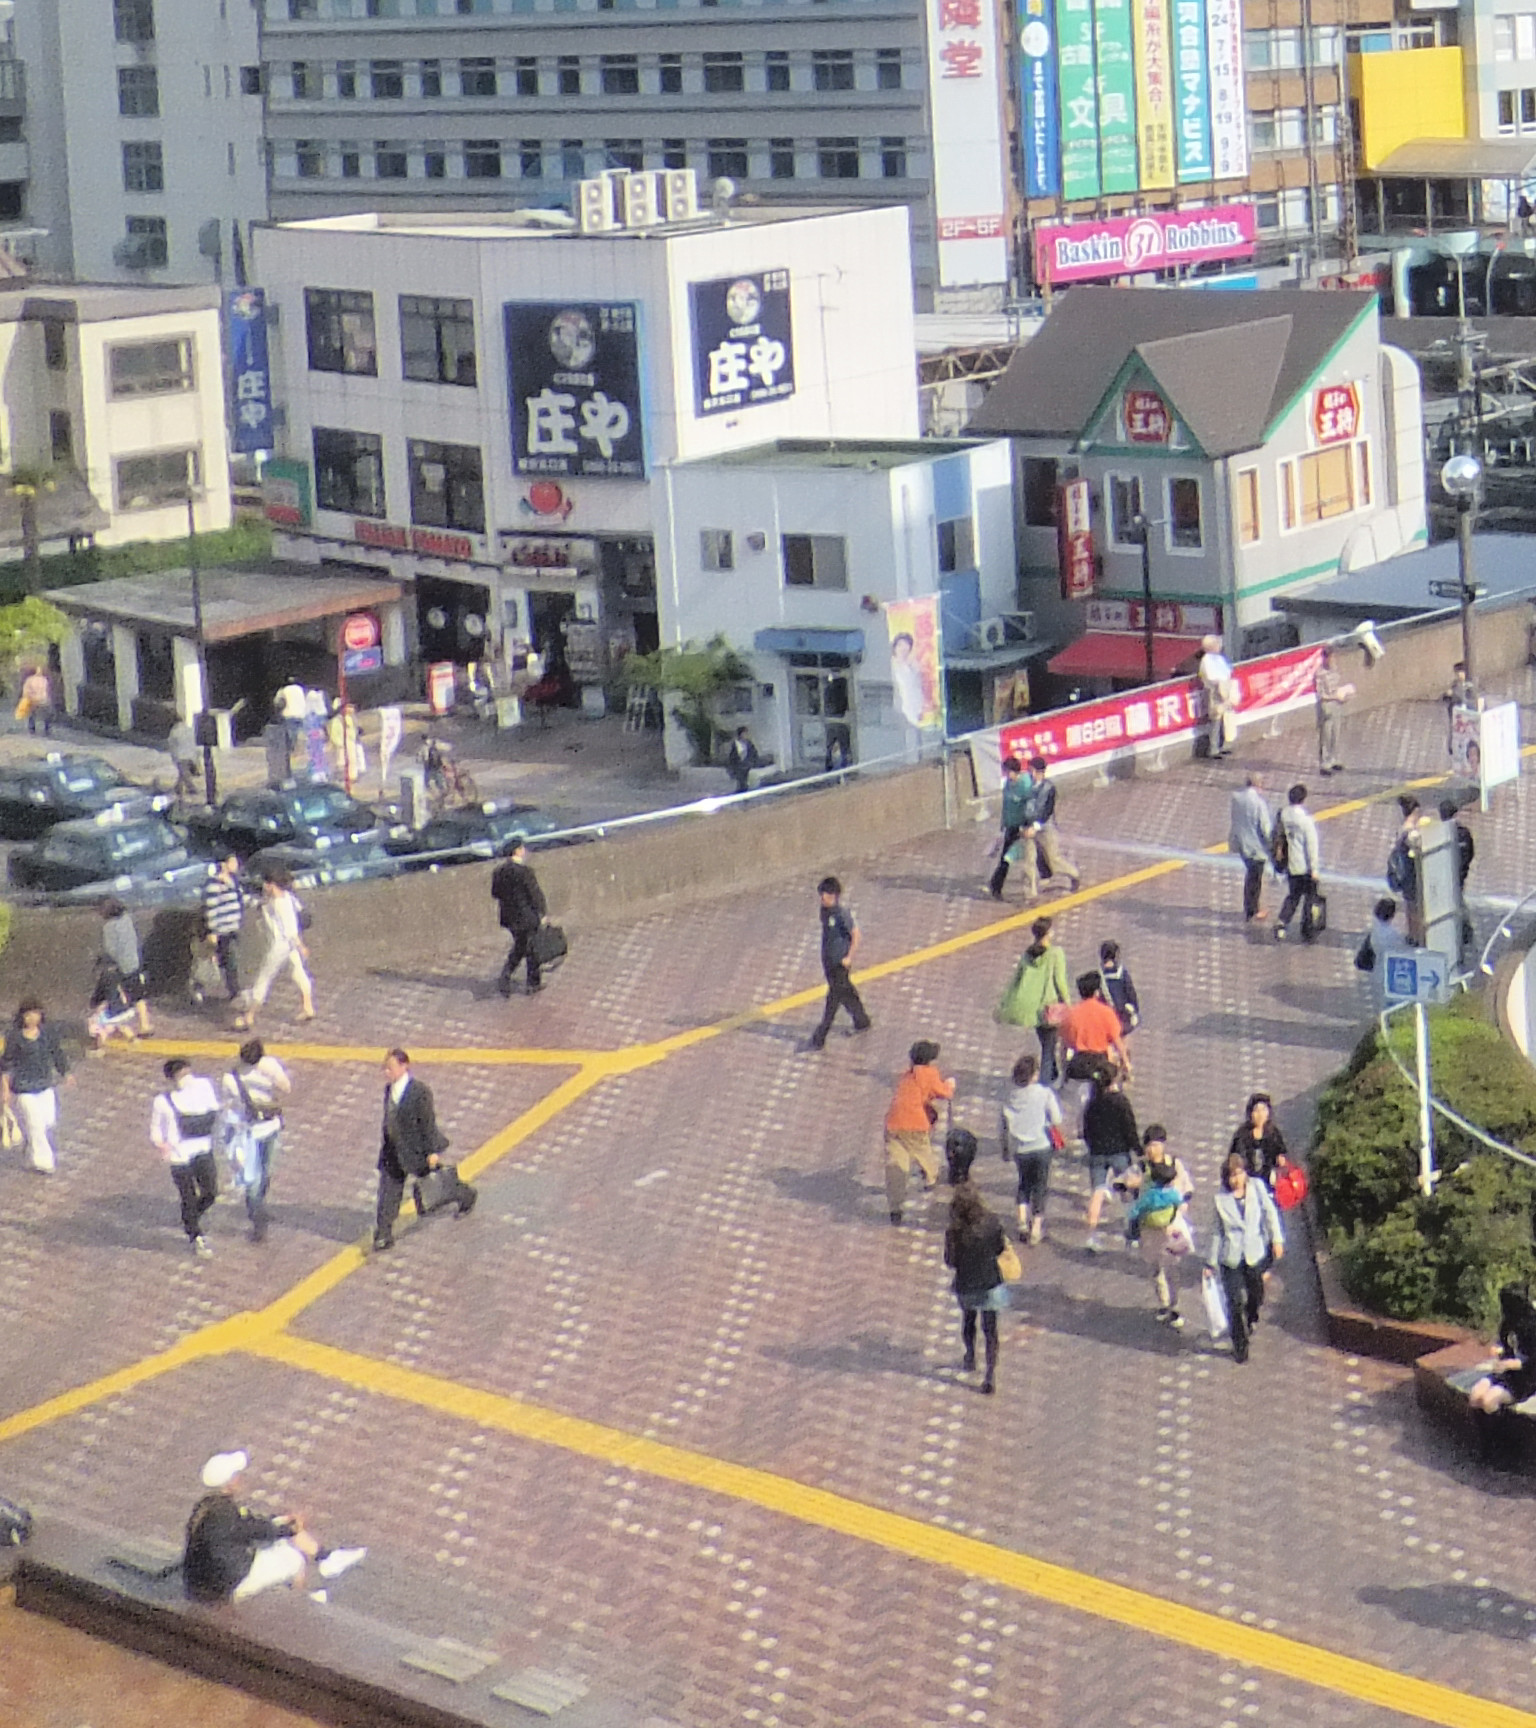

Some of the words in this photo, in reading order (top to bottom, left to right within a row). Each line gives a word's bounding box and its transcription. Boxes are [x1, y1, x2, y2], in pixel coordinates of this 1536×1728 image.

[1056, 232, 1121, 267] Baskin
[1166, 221, 1238, 252] Robbins
[708, 335, 786, 396] 庄や
[525, 387, 630, 459] 庄や
